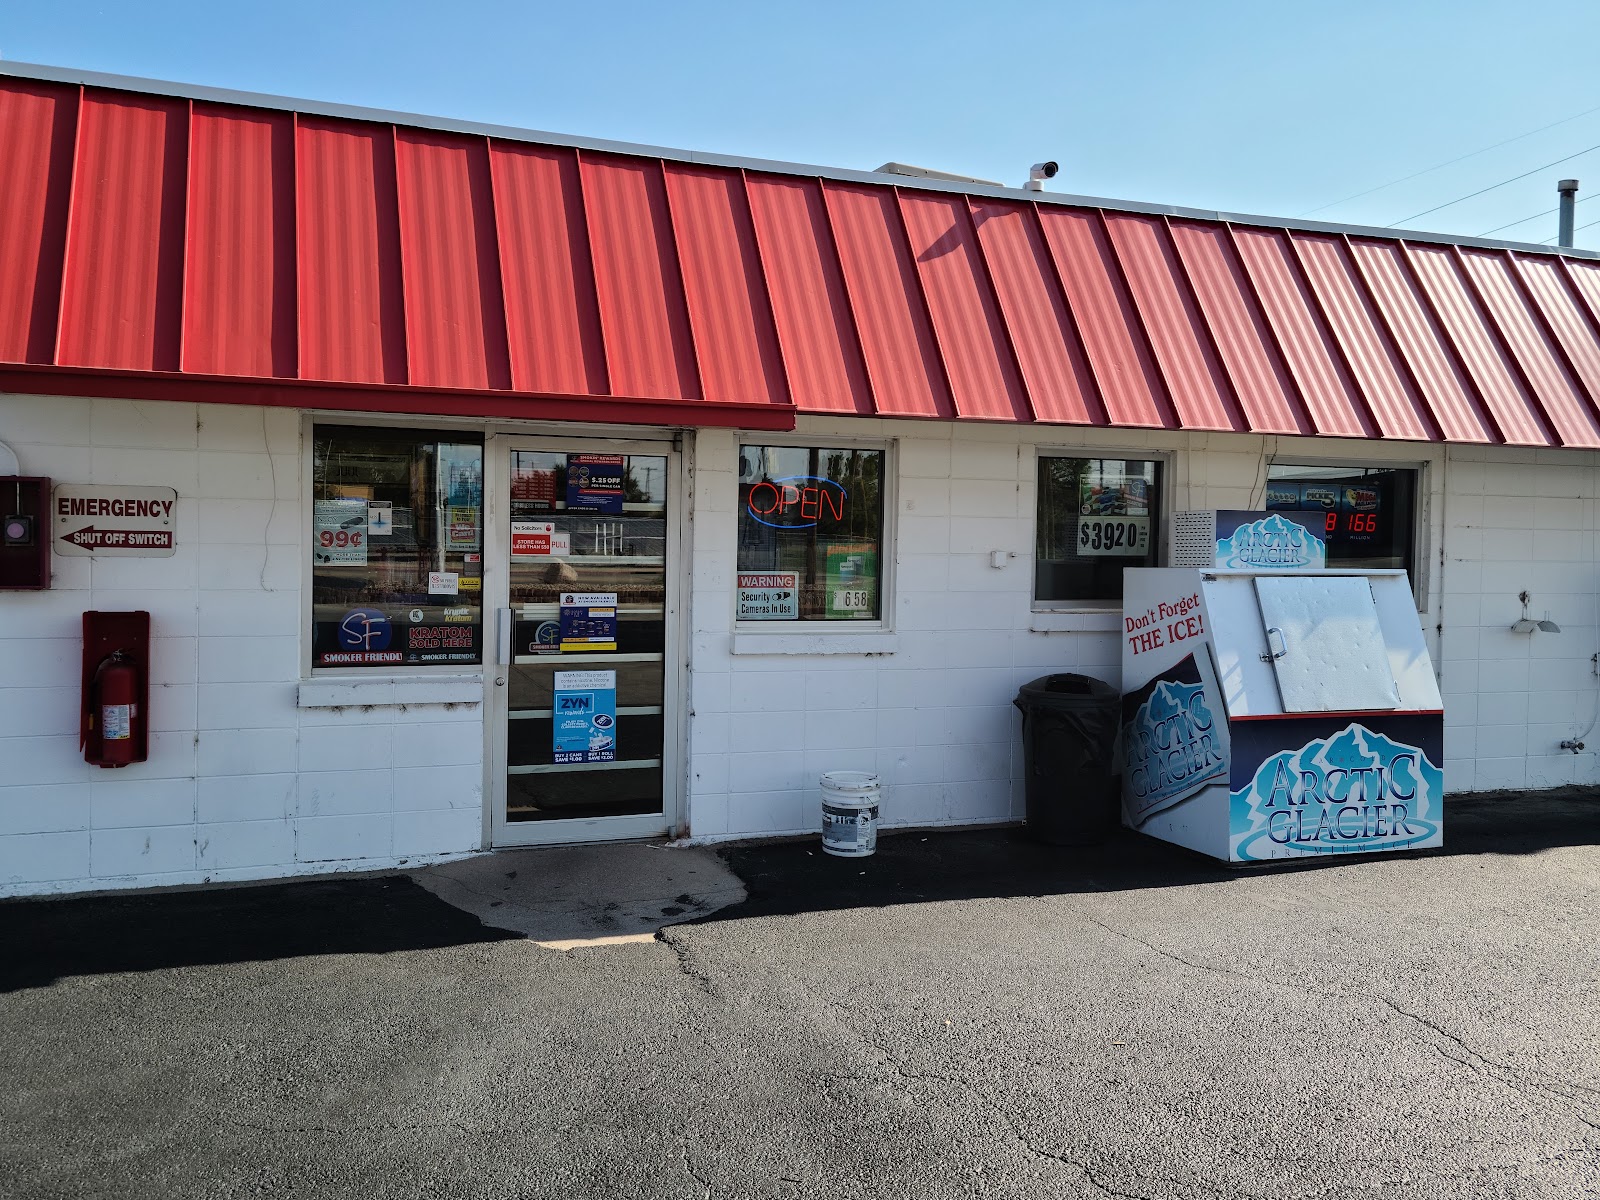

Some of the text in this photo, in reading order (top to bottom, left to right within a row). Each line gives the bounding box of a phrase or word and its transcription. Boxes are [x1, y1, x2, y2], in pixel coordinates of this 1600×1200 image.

[58, 497, 173, 518] EMERGENCY
[749, 482, 844, 521] OPEN
[1349, 513, 1377, 533] 166
[73, 532, 169, 545] SHUT OFF SWITCH
[320, 530, 363, 548] 99¢
[551, 540, 568, 549] PULL
[1239, 528, 1302, 548] ARCTIC
[1239, 548, 1301, 564] GLACIER
[740, 576, 793, 587] WARNING
[741, 591, 771, 603] Security
[844, 591, 868, 607] 6.58
[741, 604, 792, 614] Cameras In Use
[1125, 592, 1200, 634] Don't Forget
[444, 614, 473, 623] Kratom
[409, 626, 473, 639] KRATOM
[1128, 614, 1205, 655] THE ICE!
[408, 637, 472, 649] SOLD HERE
[324, 653, 362, 663] SMOKER
[421, 653, 447, 661] SMOKER
[448, 652, 477, 660] FRIENDLY
[561, 697, 589, 709] ZYN
[1126, 691, 1213, 768] ARCTIC
[1130, 733, 1222, 799] GLACIER
[1265, 754, 1416, 808] ARCTIC
[1266, 803, 1416, 844] GLACIER
[1271, 840, 1414, 859] PREMIUM ICE
